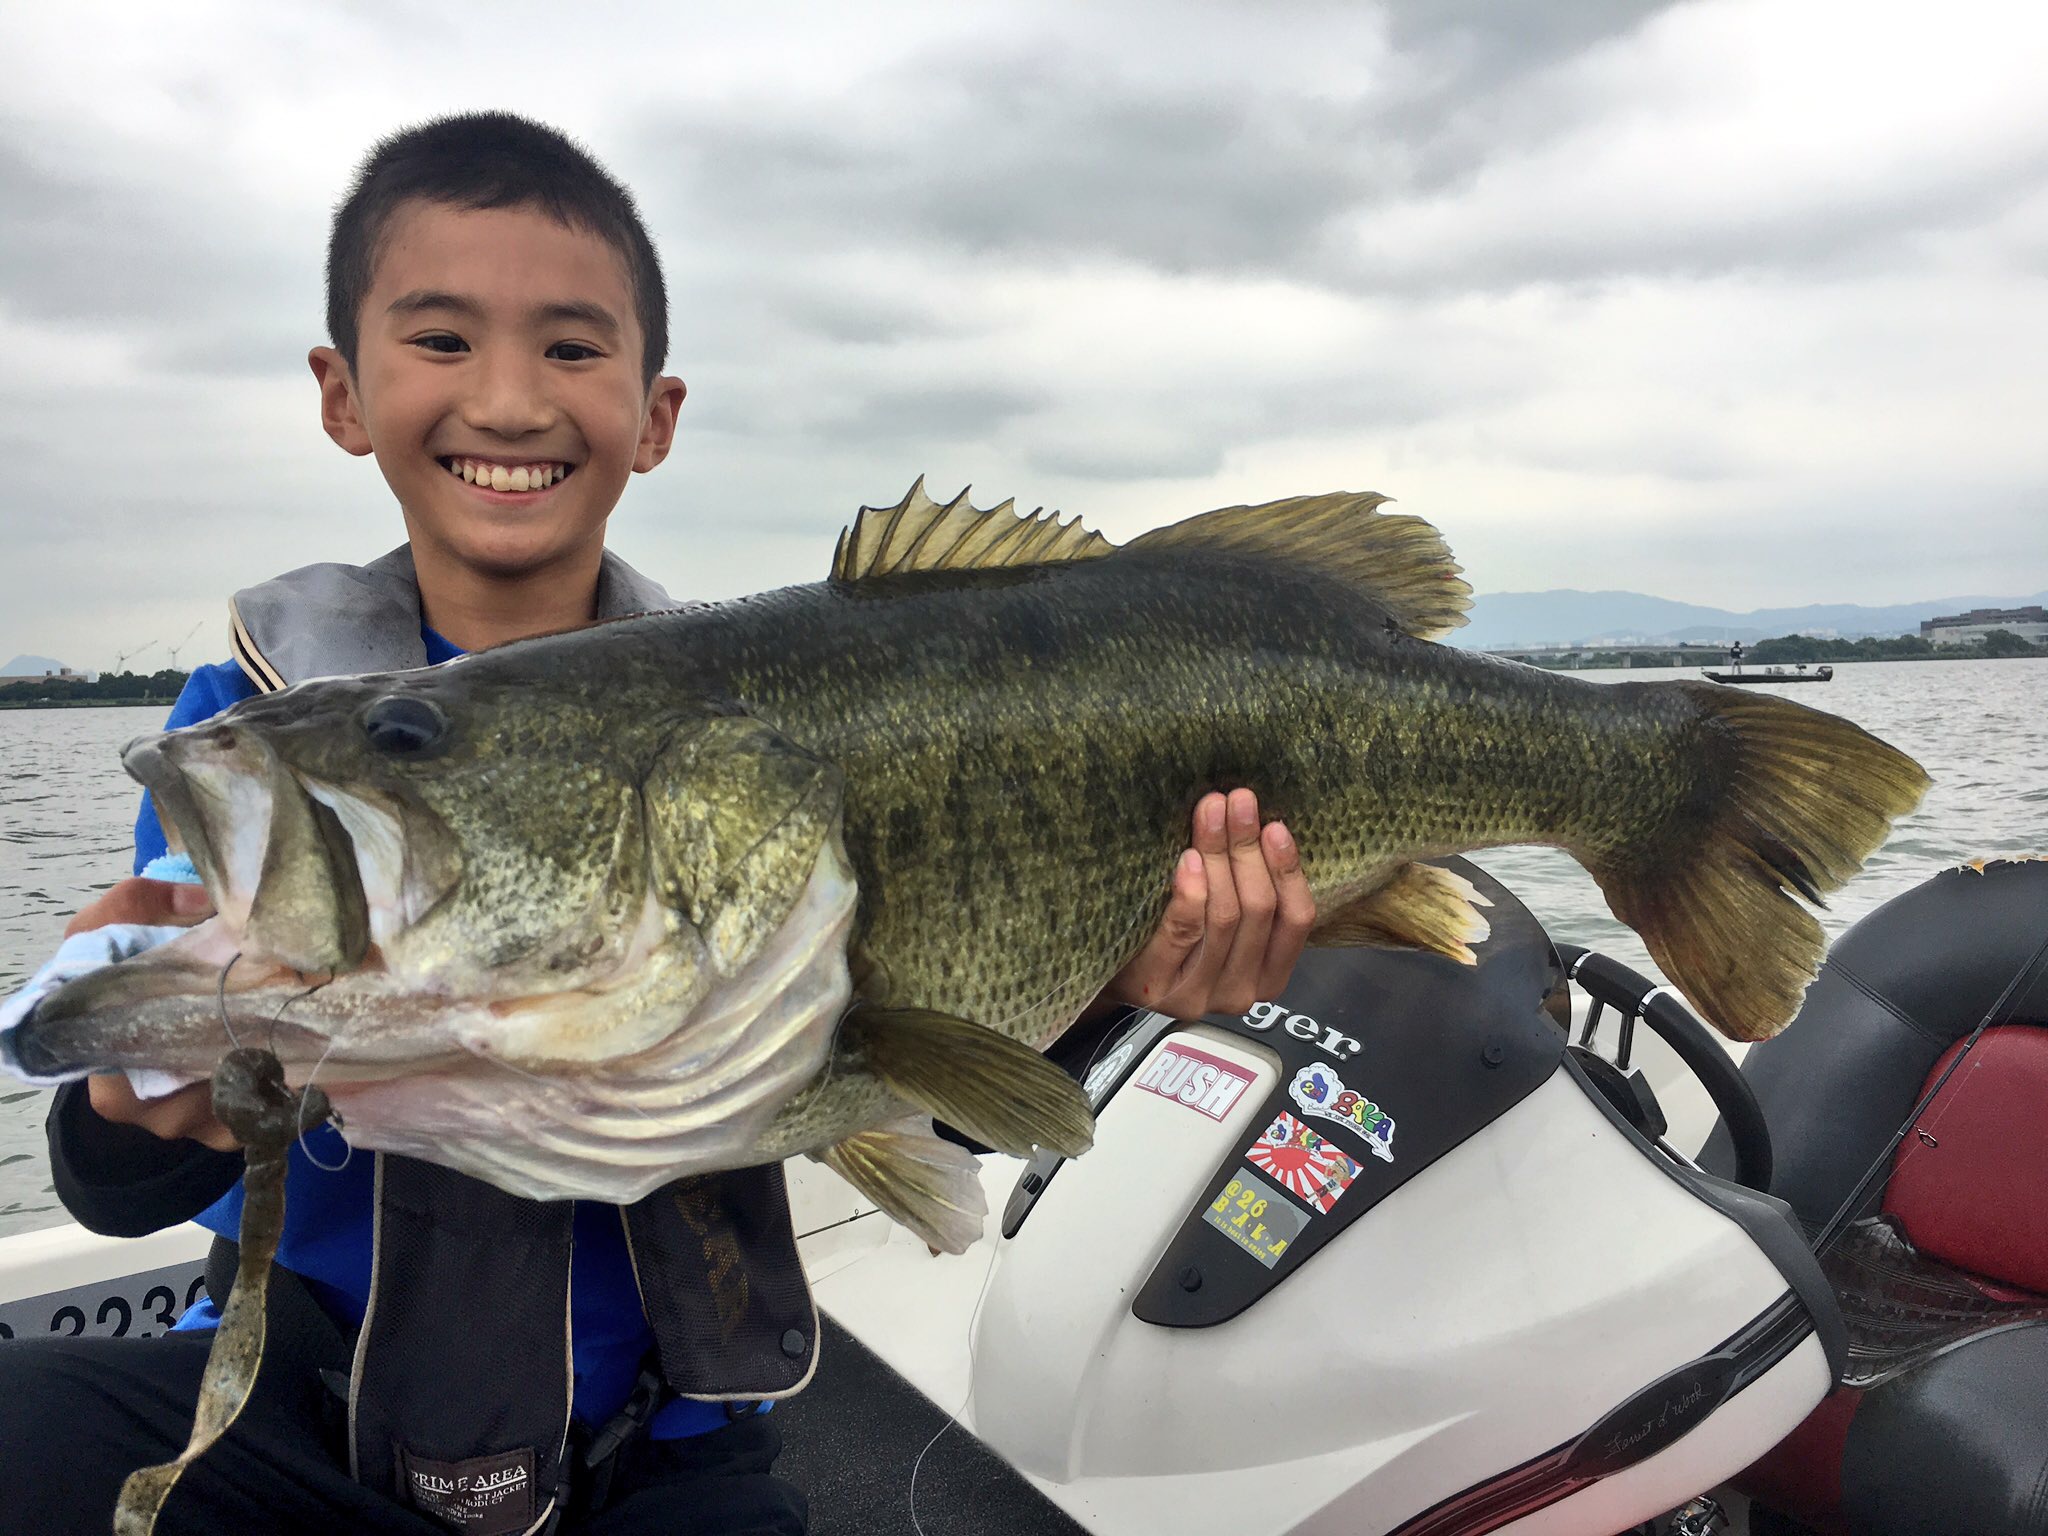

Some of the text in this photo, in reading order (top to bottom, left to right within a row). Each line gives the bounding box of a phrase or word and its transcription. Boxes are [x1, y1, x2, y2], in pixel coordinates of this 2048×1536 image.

[1136, 1049, 1250, 1120] RUSH
[1331, 1091, 1393, 1142] BAKA
[411, 1470, 468, 1493] PRIME
[475, 1465, 527, 1488] AREA
[491, 1481, 527, 1499] JACKET
